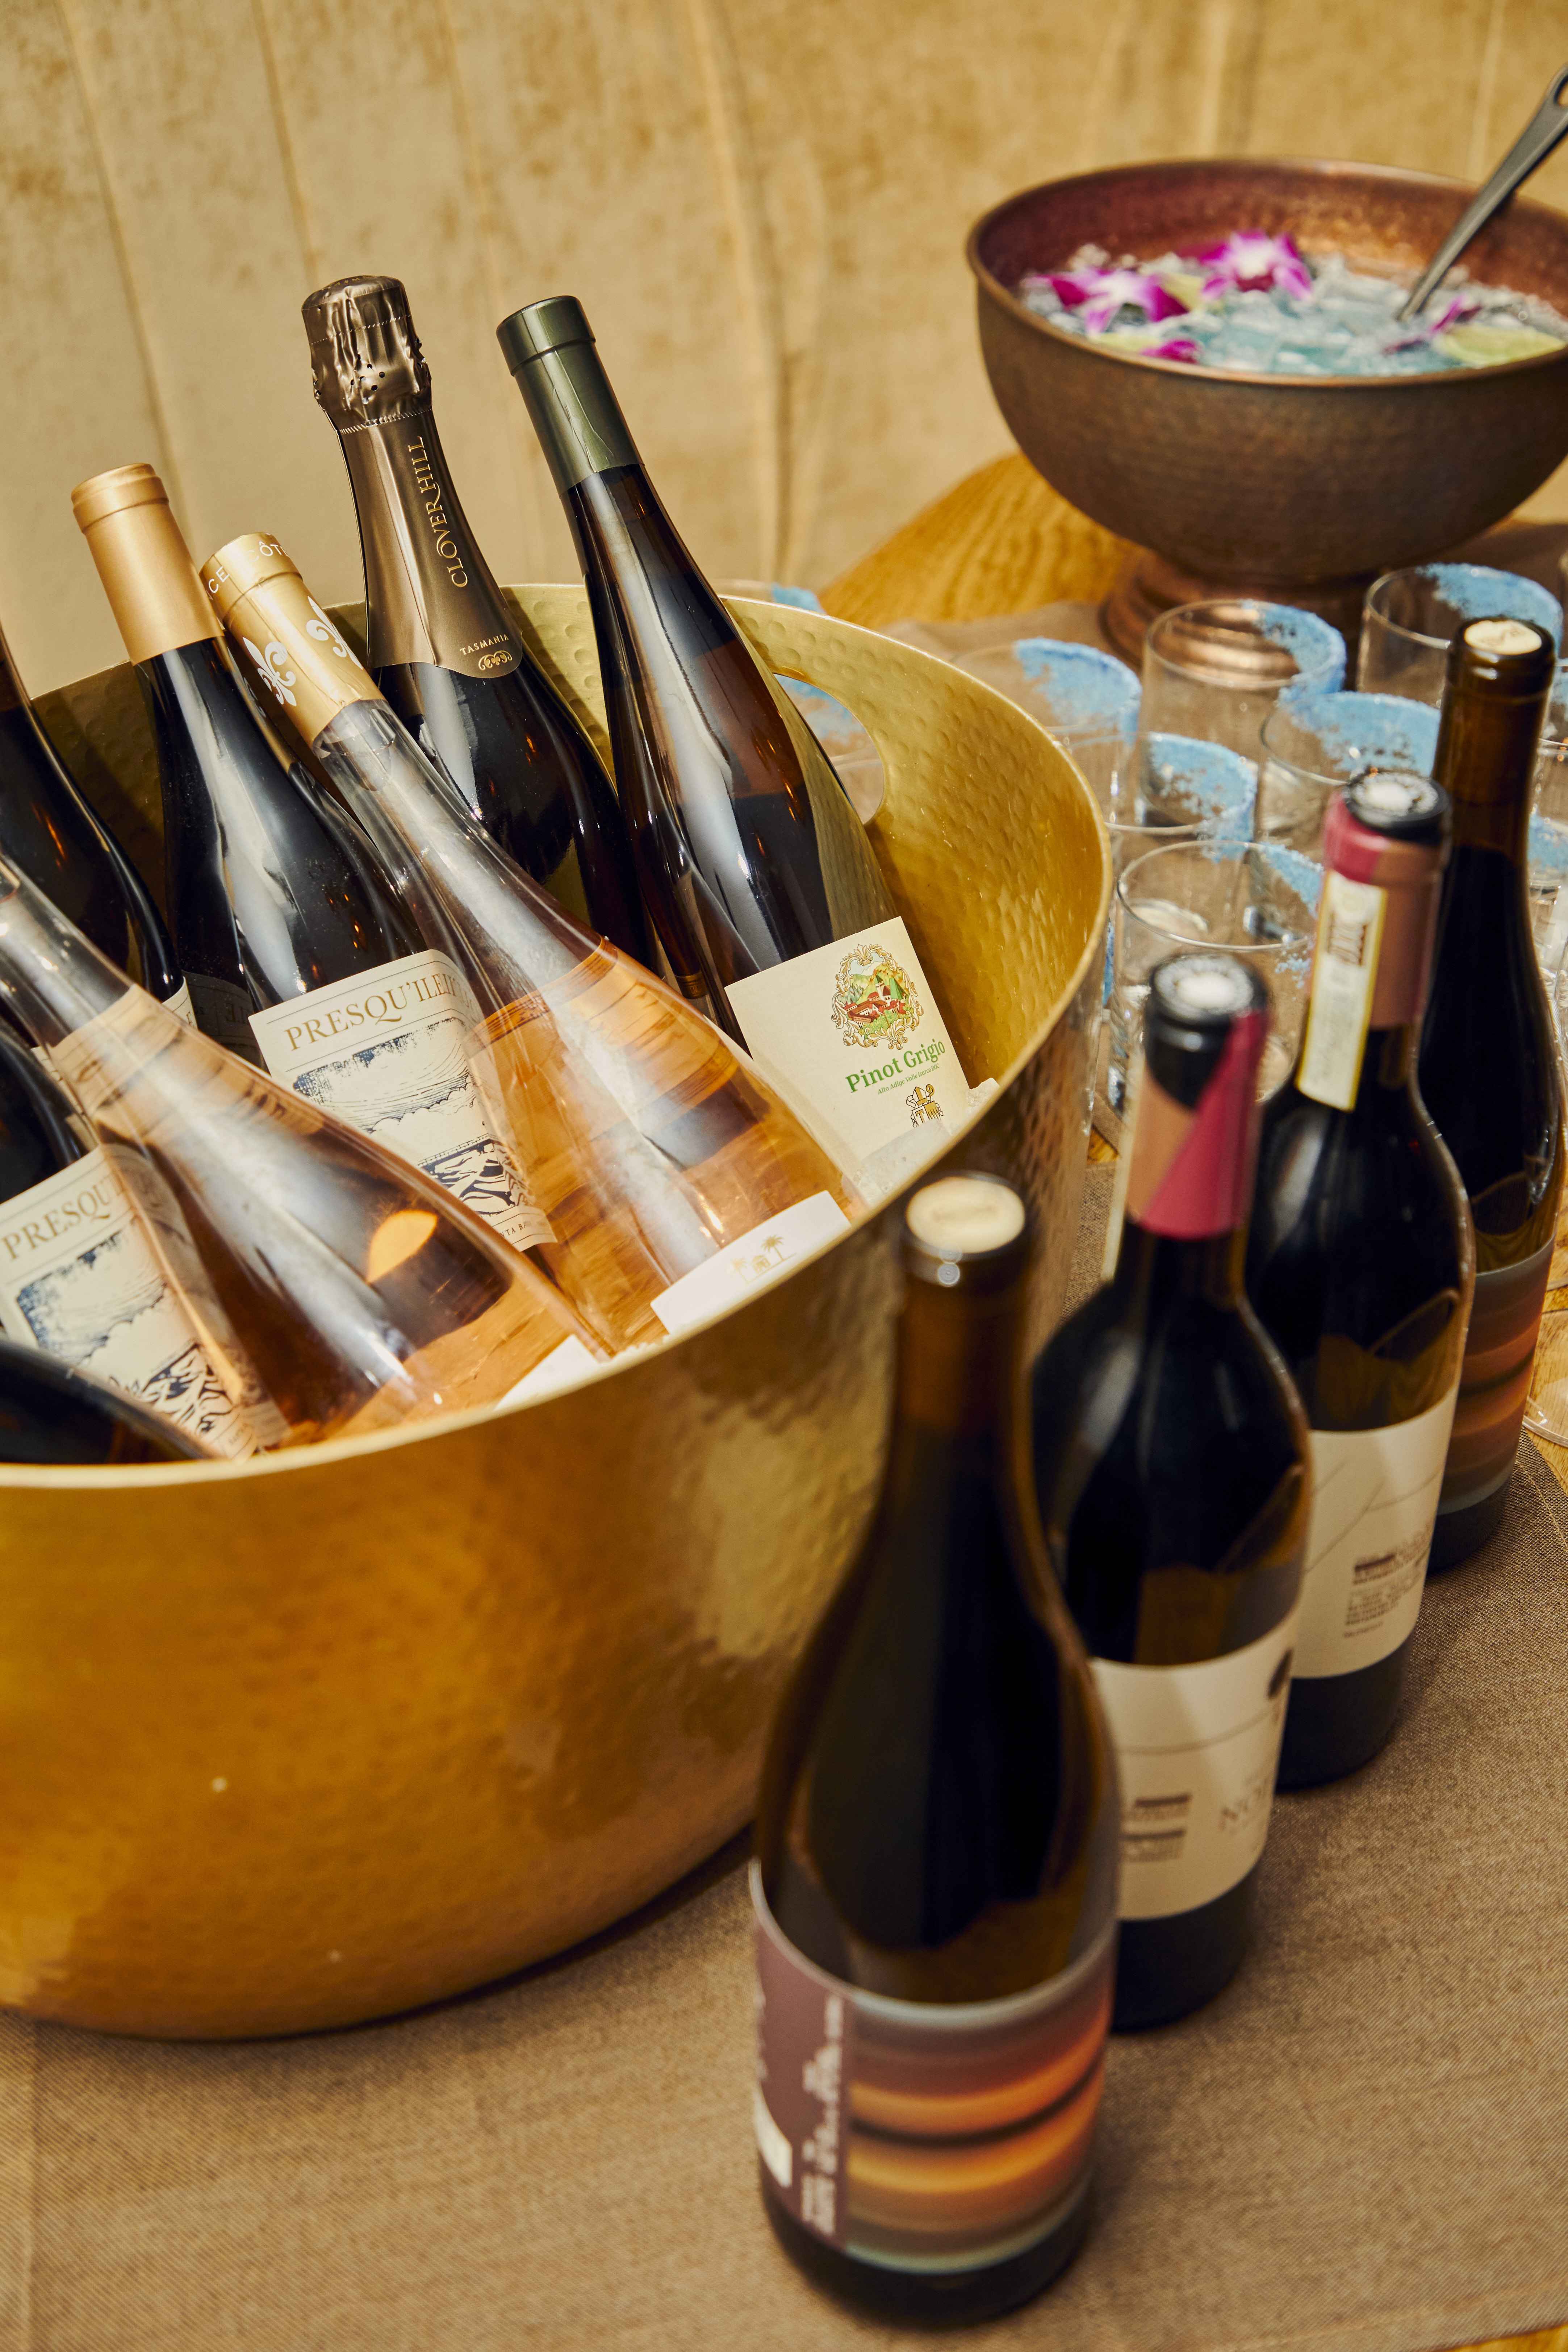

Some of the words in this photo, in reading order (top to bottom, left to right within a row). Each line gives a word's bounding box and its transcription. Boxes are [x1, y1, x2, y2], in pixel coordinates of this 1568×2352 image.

[408, 435, 436, 493] HILL
[425, 481, 468, 588] CLOVER
[460, 634, 509, 655] TASMANIA
[284, 973, 447, 1051] PRESQU'ILE
[845, 1058, 903, 1093] Pinot
[903, 1039, 945, 1068] Grigio
[878, 1086, 889, 1095] Alto
[890, 1079, 905, 1089] Adige
[906, 1074, 917, 1082] Valle
[918, 1068, 932, 1077] Isarco
[931, 1063, 940, 1071] DOC
[499, 1227, 516, 1238] NTA
